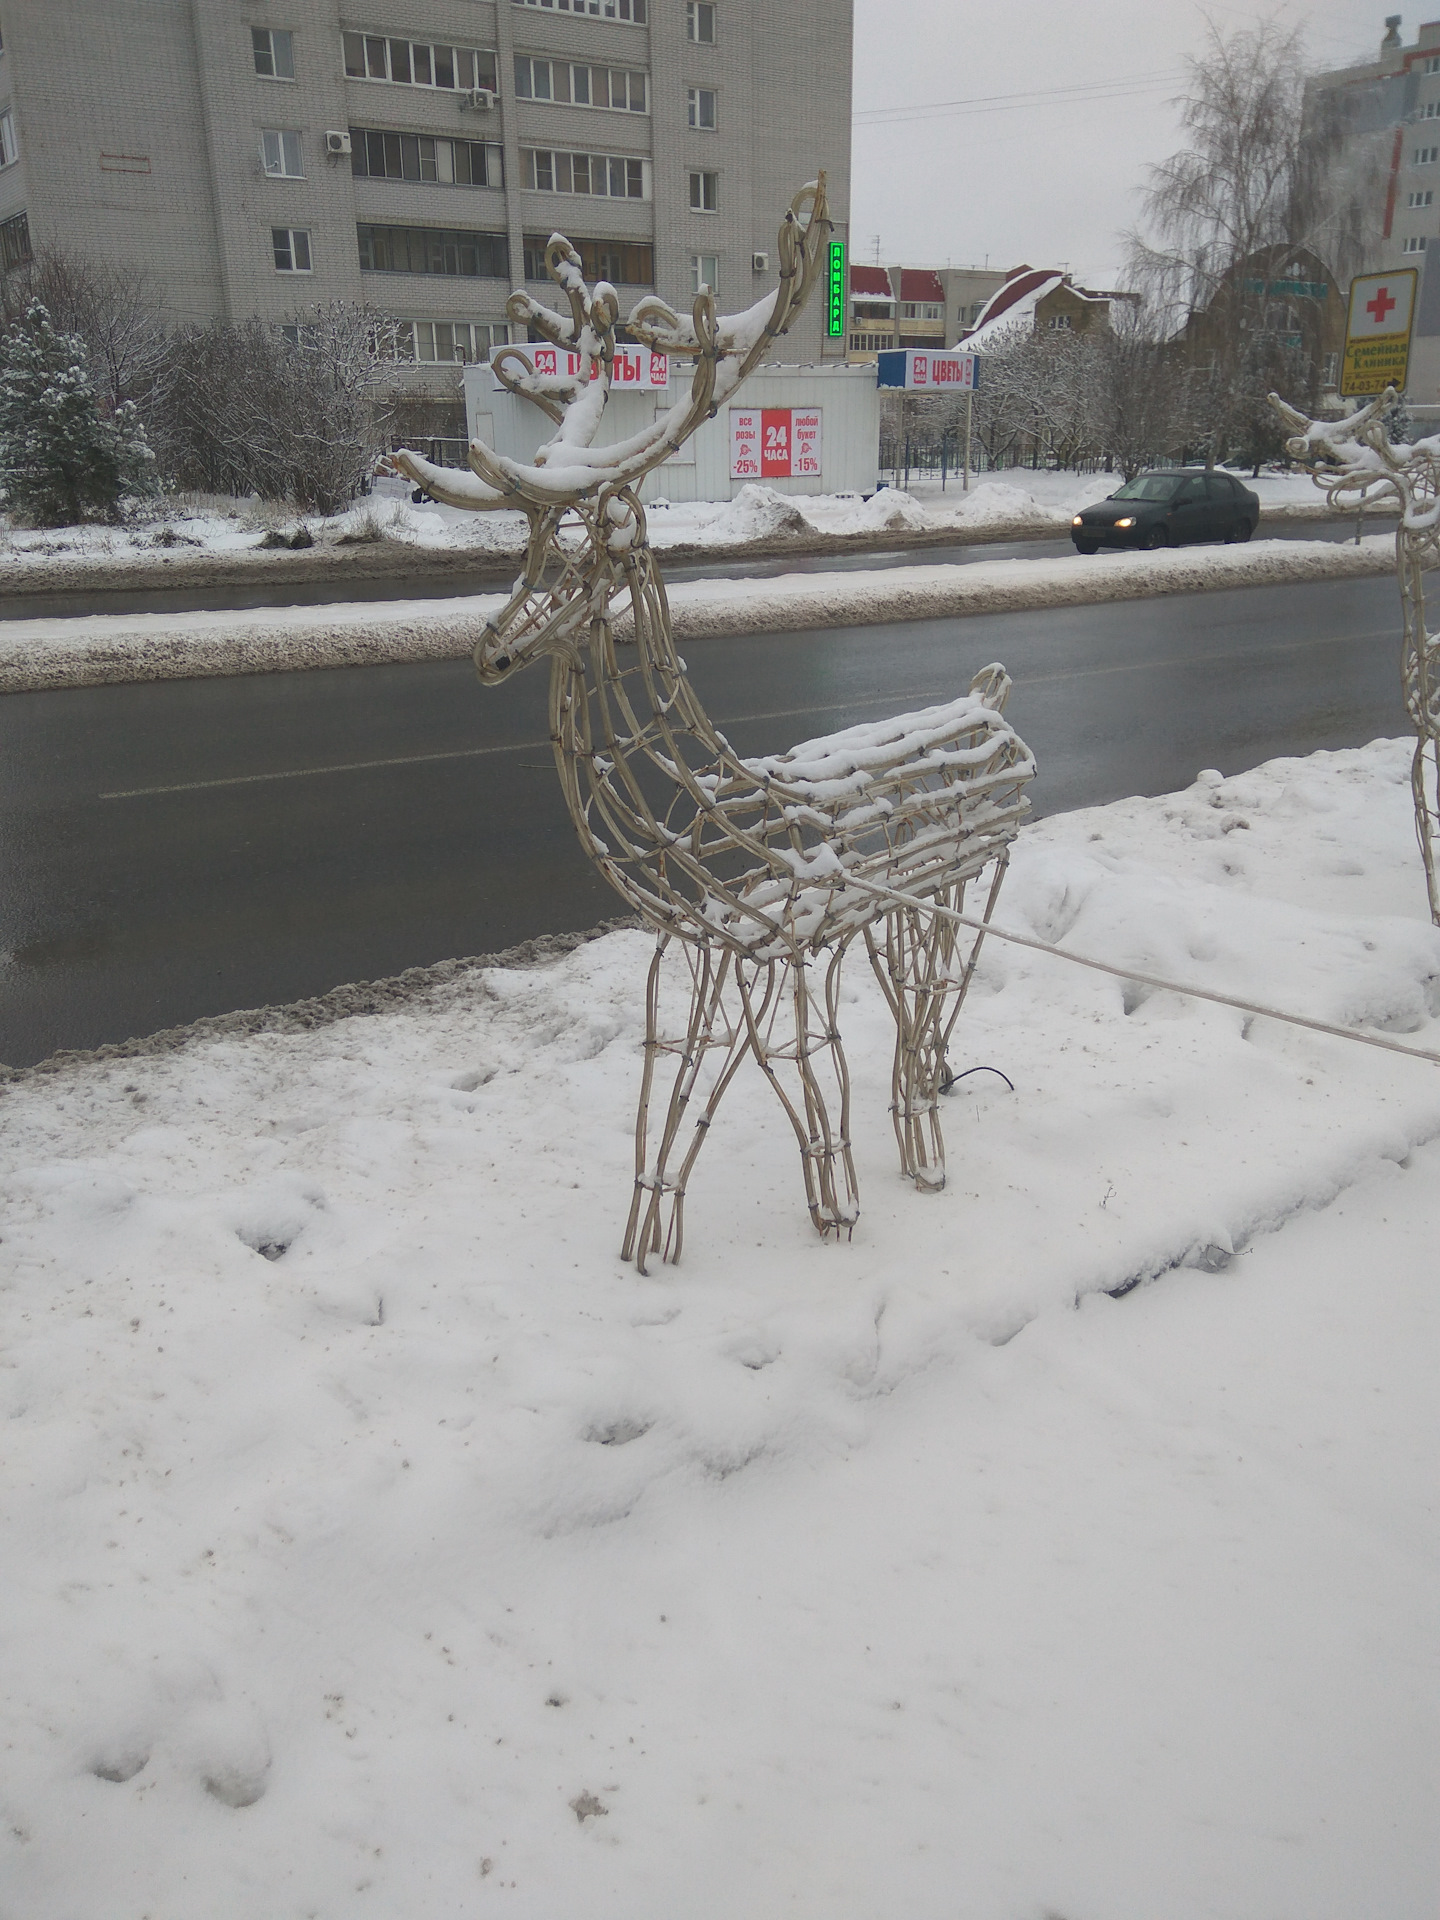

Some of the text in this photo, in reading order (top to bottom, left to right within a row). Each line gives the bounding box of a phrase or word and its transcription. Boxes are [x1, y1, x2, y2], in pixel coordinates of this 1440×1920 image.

[833, 246, 841, 332] ЛОМБАРД
[1346, 343, 1407, 358] Семейная
[537, 353, 555, 370] 24
[652, 355, 666, 372] 24
[915, 359, 927, 373] 24
[1354, 356, 1405, 369] Клиника
[932, 359, 964, 386] ЦВЕТЫ
[1344, 379, 1386, 392] 74-03-74
[739, 417, 752, 426] все
[795, 415, 819, 427] любой
[735, 430, 756, 441] розы
[766, 426, 788, 447] 24
[797, 428, 816, 441] букет
[764, 449, 789, 461] ЧАСА
[733, 459, 758, 474] -25%
[794, 457, 818, 472] -15%
